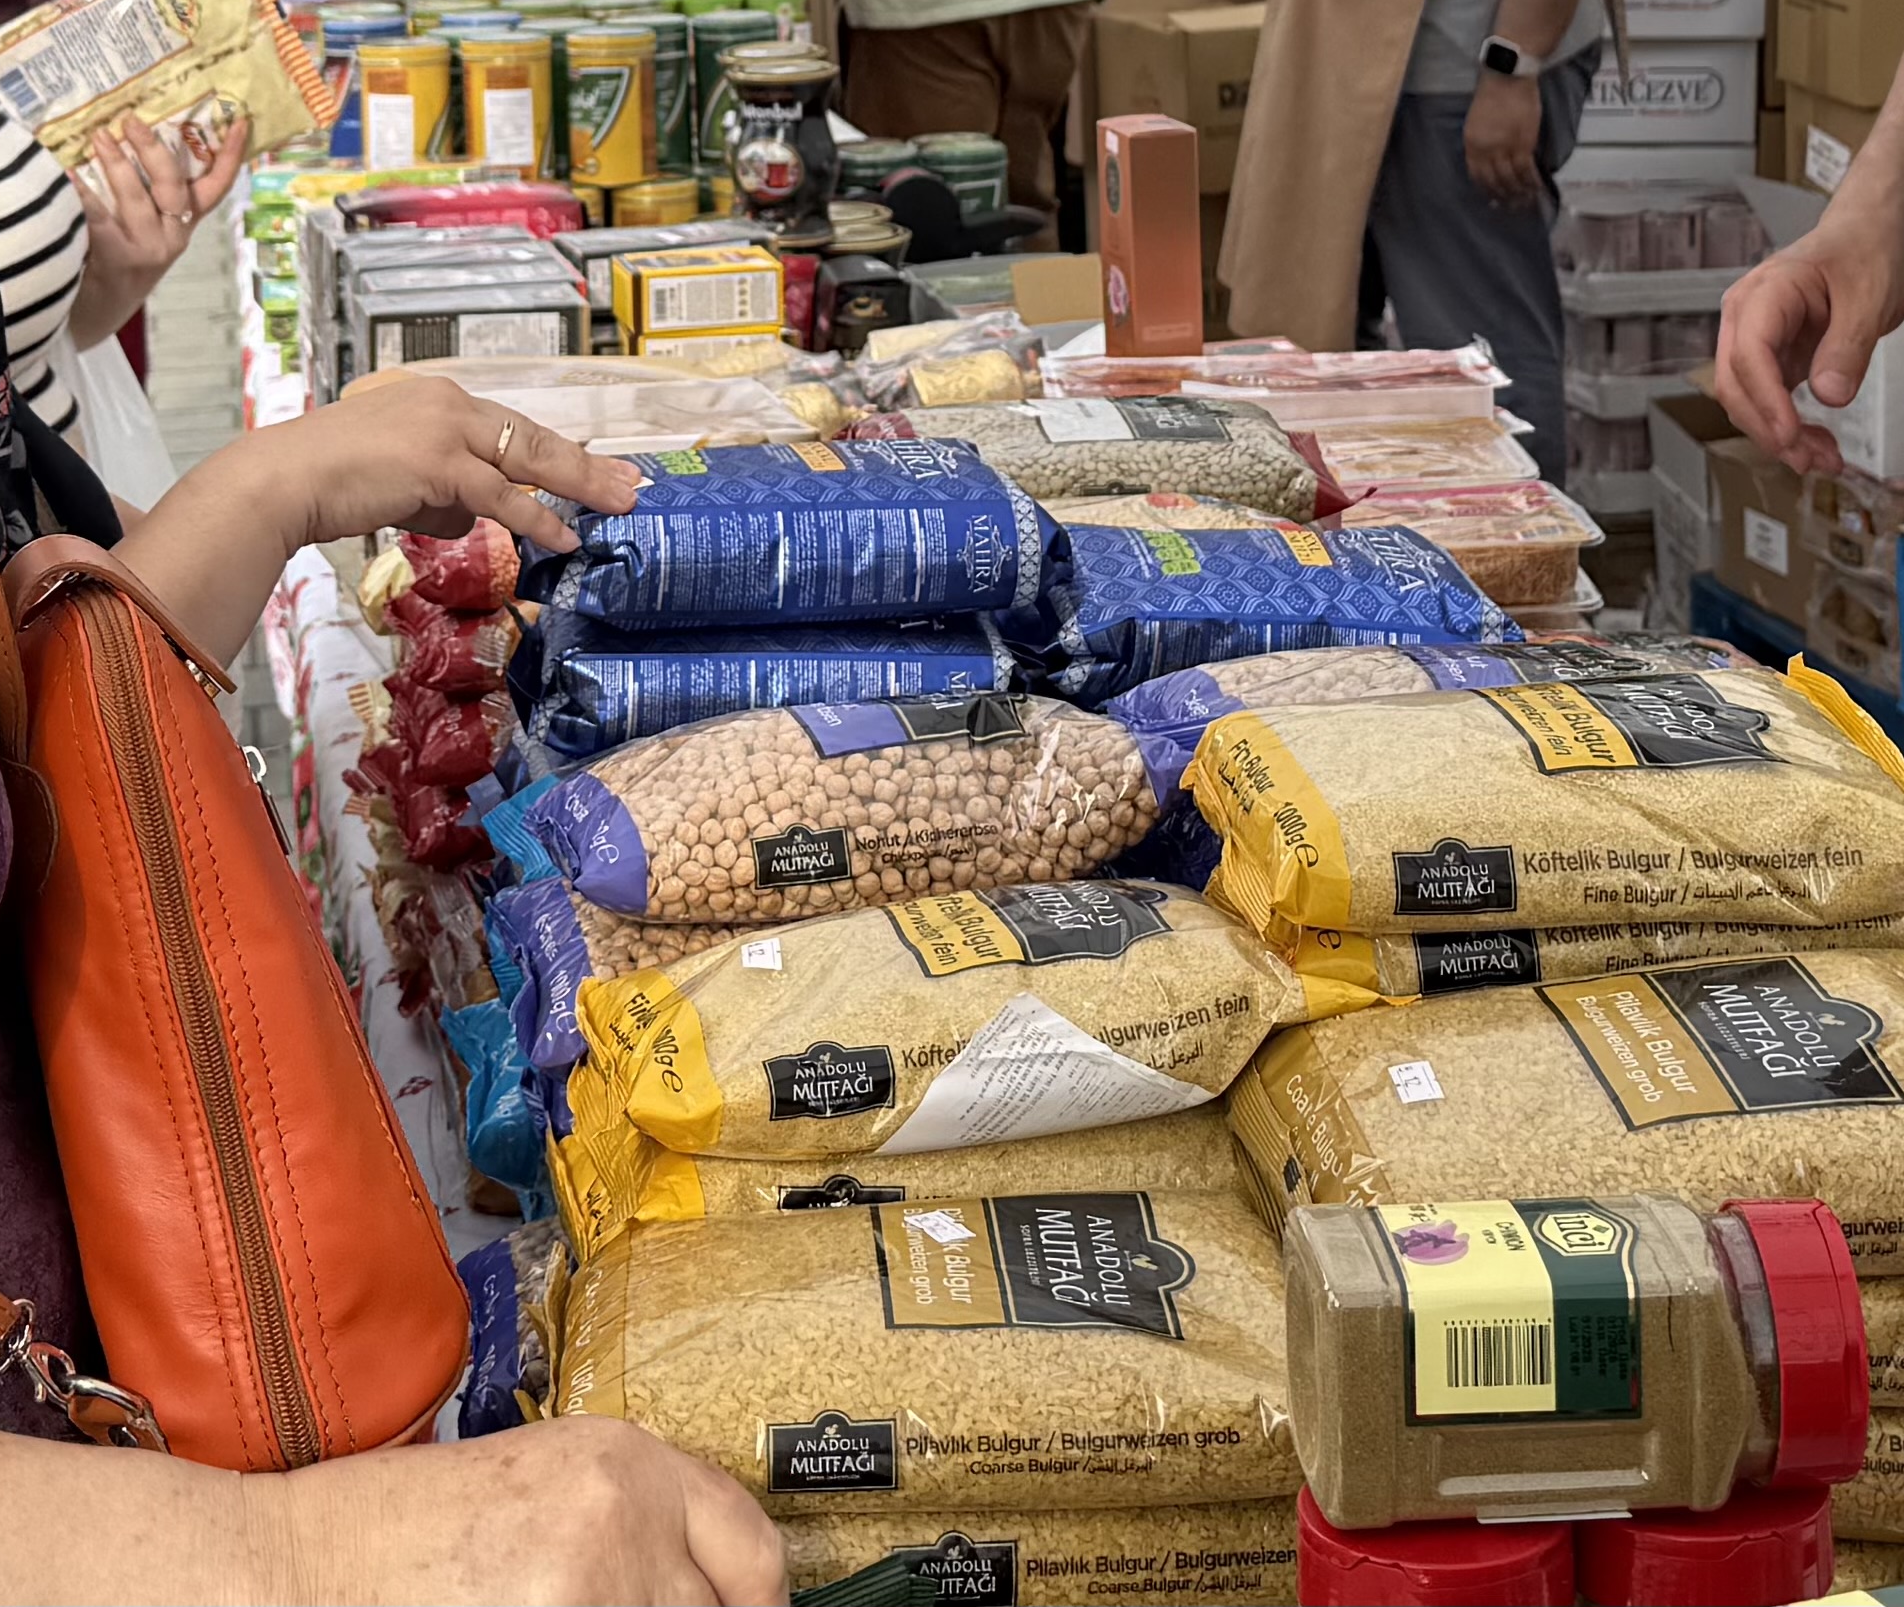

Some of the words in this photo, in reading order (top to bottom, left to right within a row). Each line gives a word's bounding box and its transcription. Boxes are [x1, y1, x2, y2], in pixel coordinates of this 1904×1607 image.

[973, 514, 991, 593] MAHRA
[774, 841, 829, 857] ANADOLU
[856, 834, 901, 851] Nohut
[1420, 864, 1489, 880] ANADOLU
[1523, 849, 1602, 875] Köftelik
[1606, 849, 1672, 874] Bulgur
[1824, 845, 1863, 866] fein
[1417, 875, 1496, 900] MUTFAĞI
[1584, 885, 1618, 905] Fine
[1623, 884, 1676, 906] Bulgur
[956, 914, 1005, 959] Bulgur
[1441, 937, 1511, 956] ANADOLU
[1439, 949, 1518, 975] MUTFAĞI
[1214, 993, 1250, 1019] fein
[1702, 983, 1809, 1079] MUTFAĞI
[1753, 984, 1841, 1069] ANADOLU
[1575, 995, 1639, 1072] Bulgurweizen
[1626, 1064, 1661, 1104] grob
[794, 1061, 867, 1080] ANADOLU
[1645, 1039, 1699, 1094] Bulgur
[792, 1073, 874, 1102] MUTFAĞI
[1553, 1214, 1605, 1248] inci
[1035, 1207, 1099, 1307] MUTFAĞI
[1086, 1213, 1131, 1306] ANADOLU
[911, 1276, 937, 1305] grob
[942, 1254, 975, 1304] Bulgur
[795, 1436, 869, 1453] ANADOLU
[977, 1433, 1041, 1454] Bulgur
[1061, 1429, 1190, 1453] Bulgurweizen
[1193, 1426, 1241, 1449] grob
[790, 1450, 875, 1475] MUTFAĞI
[969, 1459, 1024, 1475] Coarse
[1028, 1458, 1078, 1476] Bulgur
[919, 1559, 992, 1575] ANADOLU
[1095, 1554, 1157, 1575] Bulgur
[1087, 1578, 1140, 1596] Coarse
[1142, 1576, 1193, 1594] Bulgur
